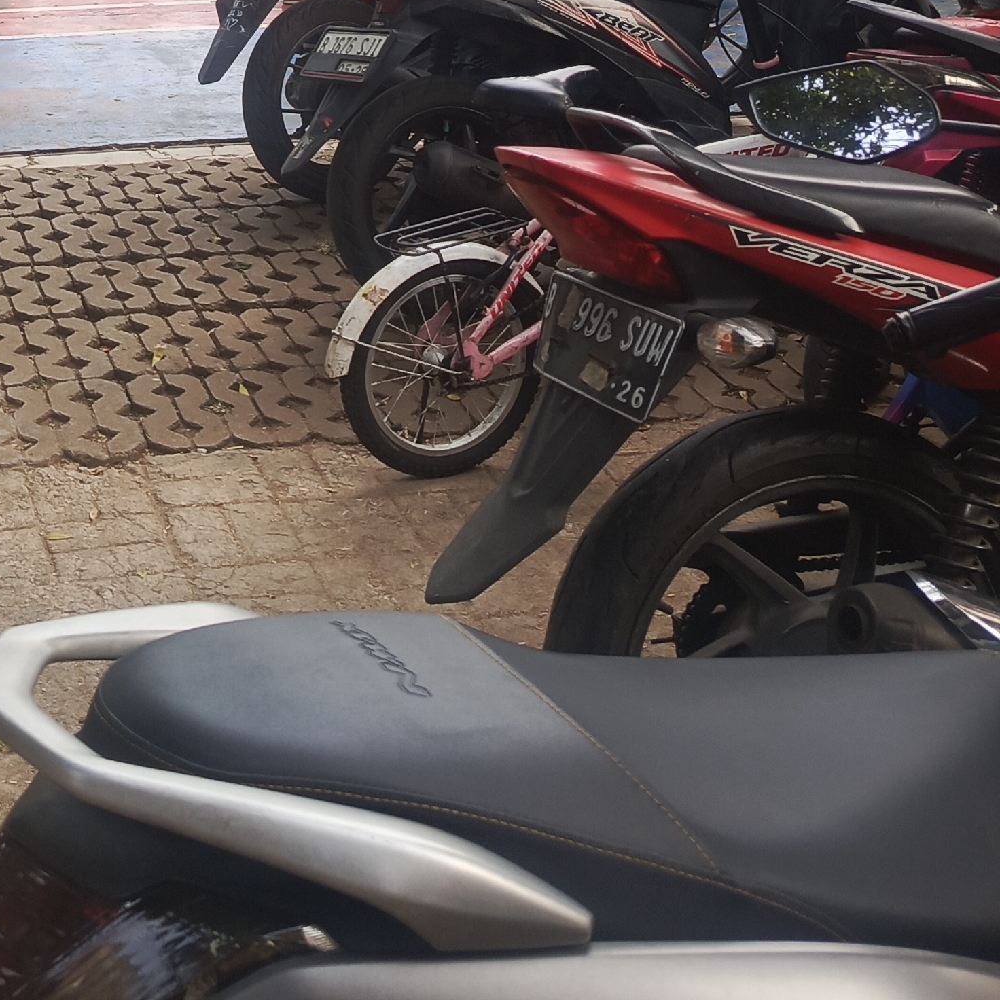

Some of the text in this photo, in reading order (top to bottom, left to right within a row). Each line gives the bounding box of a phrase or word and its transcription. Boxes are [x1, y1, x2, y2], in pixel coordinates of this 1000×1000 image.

[728, 225, 941, 301] VERZA
[831, 273, 907, 301] 150
[562, 297, 619, 343] 996
[619, 314, 675, 367] SUW
